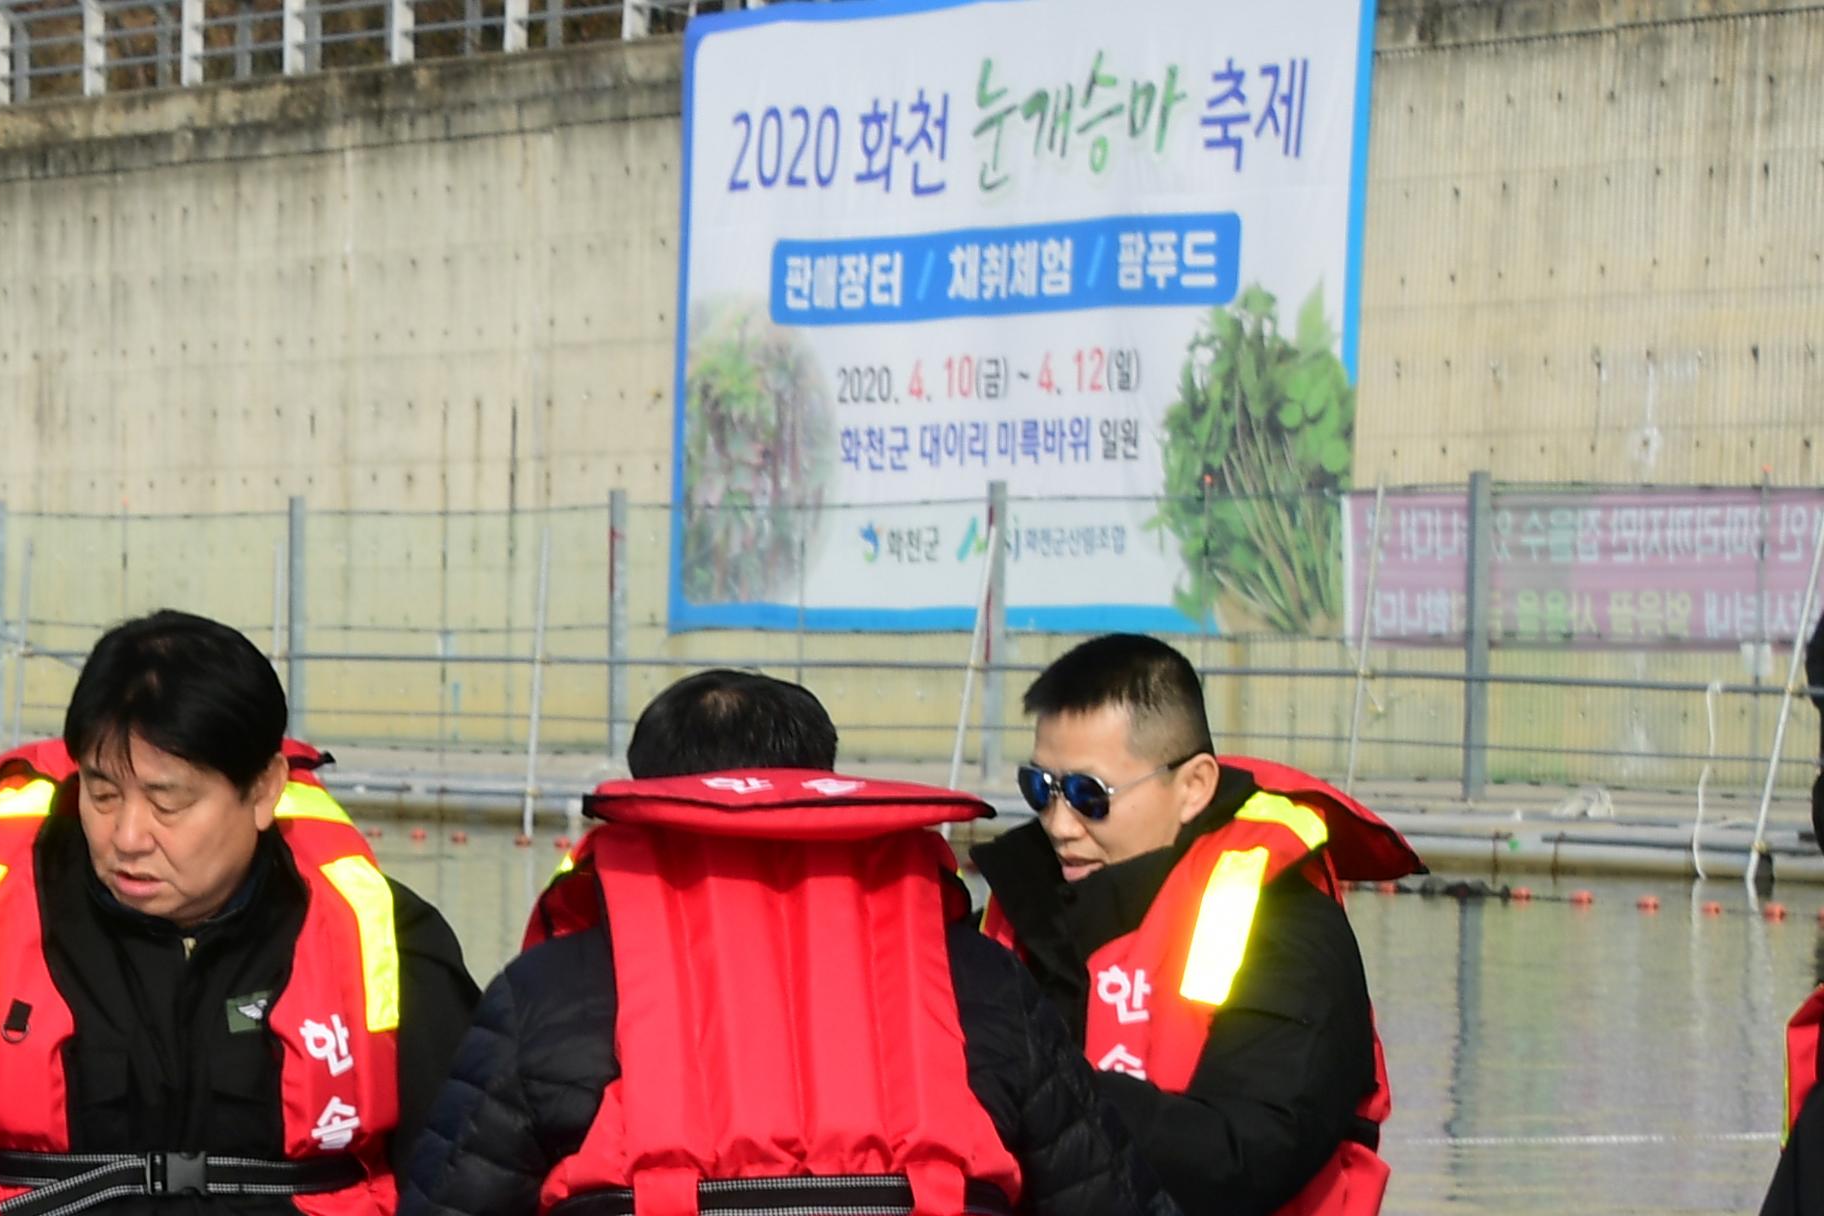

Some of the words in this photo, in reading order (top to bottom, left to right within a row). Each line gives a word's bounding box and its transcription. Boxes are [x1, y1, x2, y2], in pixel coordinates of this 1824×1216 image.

[728, 105, 840, 191] 2020
[855, 88, 949, 196] 화천
[973, 51, 1188, 193] 눈개승마
[1200, 58, 1309, 172] 축제
[947, 237, 1073, 299] 채취체험
[1117, 231, 1218, 290] 팜푸드
[837, 367, 900, 404] 2020.
[840, 424, 910, 472] 화천군
[920, 420, 989, 468] 대이리
[997, 416, 1092, 465] 미륵바위
[1099, 418, 1139, 461] 일원
[888, 525, 940, 562] 화천군
